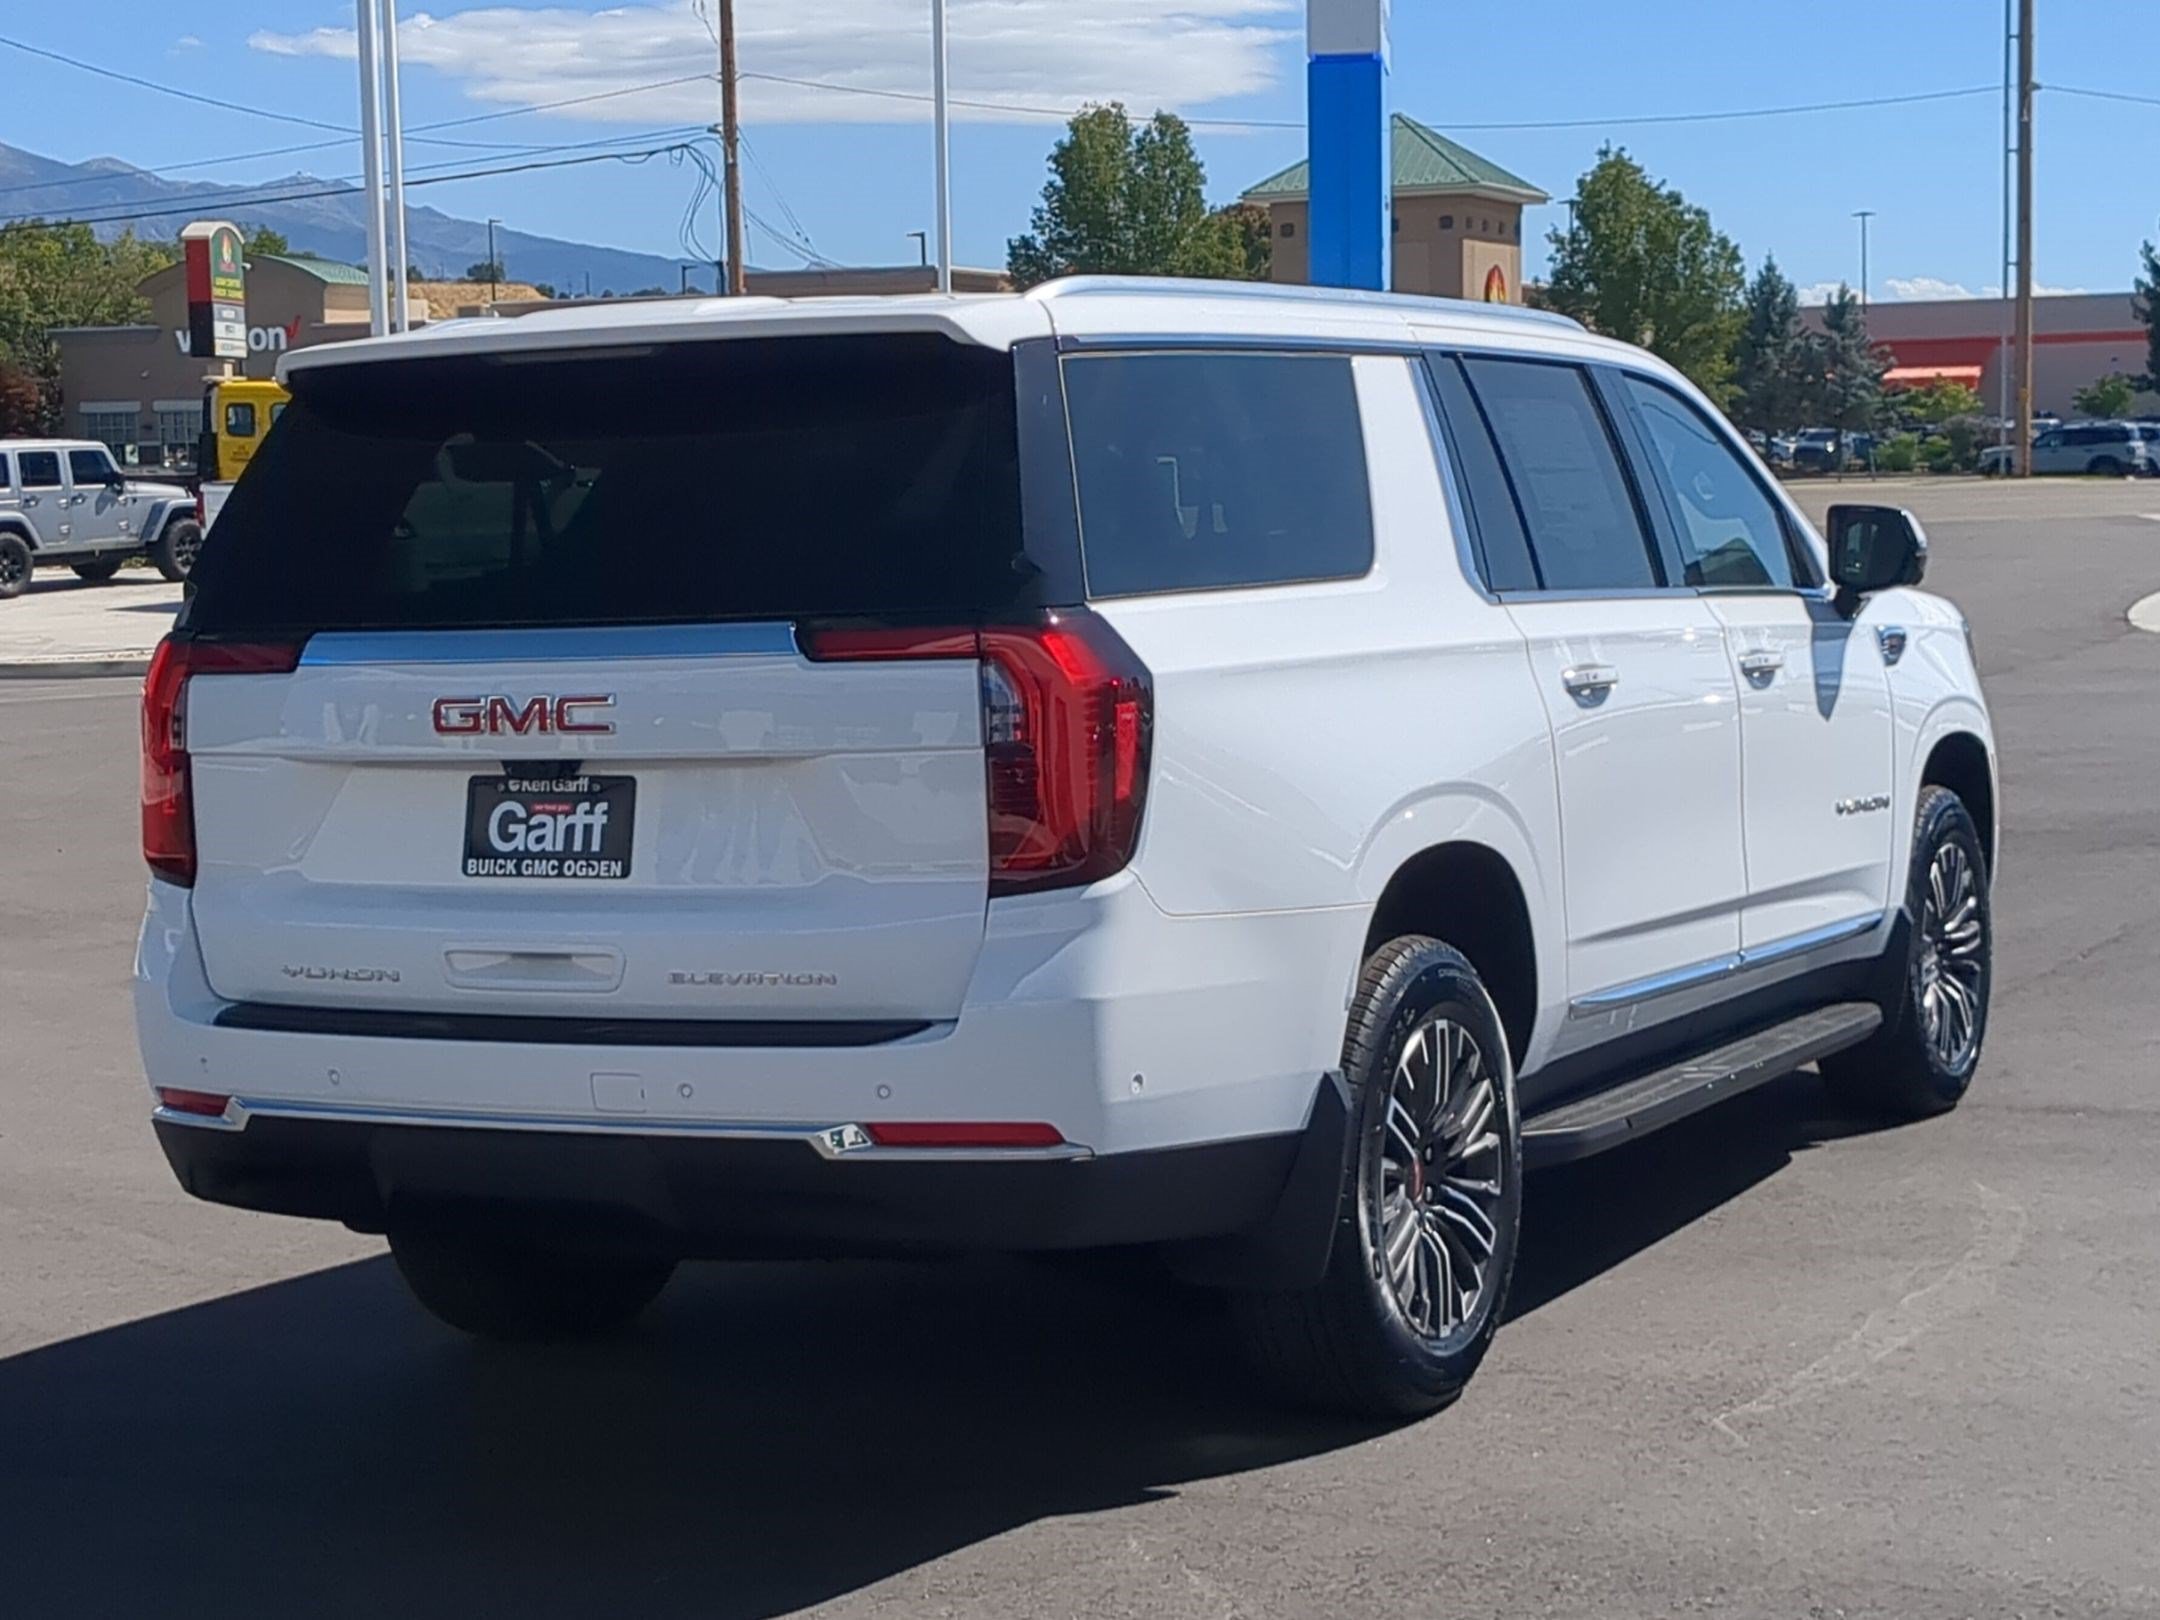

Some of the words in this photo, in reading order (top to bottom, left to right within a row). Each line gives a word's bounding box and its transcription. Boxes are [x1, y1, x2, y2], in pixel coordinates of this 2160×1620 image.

[432, 694, 616, 736] GMC
[551, 776, 590, 793] Garff
[488, 800, 609, 853] Garff
[467, 858, 517, 875] BUICK
[521, 859, 559, 876] GMC
[563, 860, 622, 877] OGDEN
[281, 965, 401, 983] YUKON
[668, 971, 838, 986] ELEVATION
